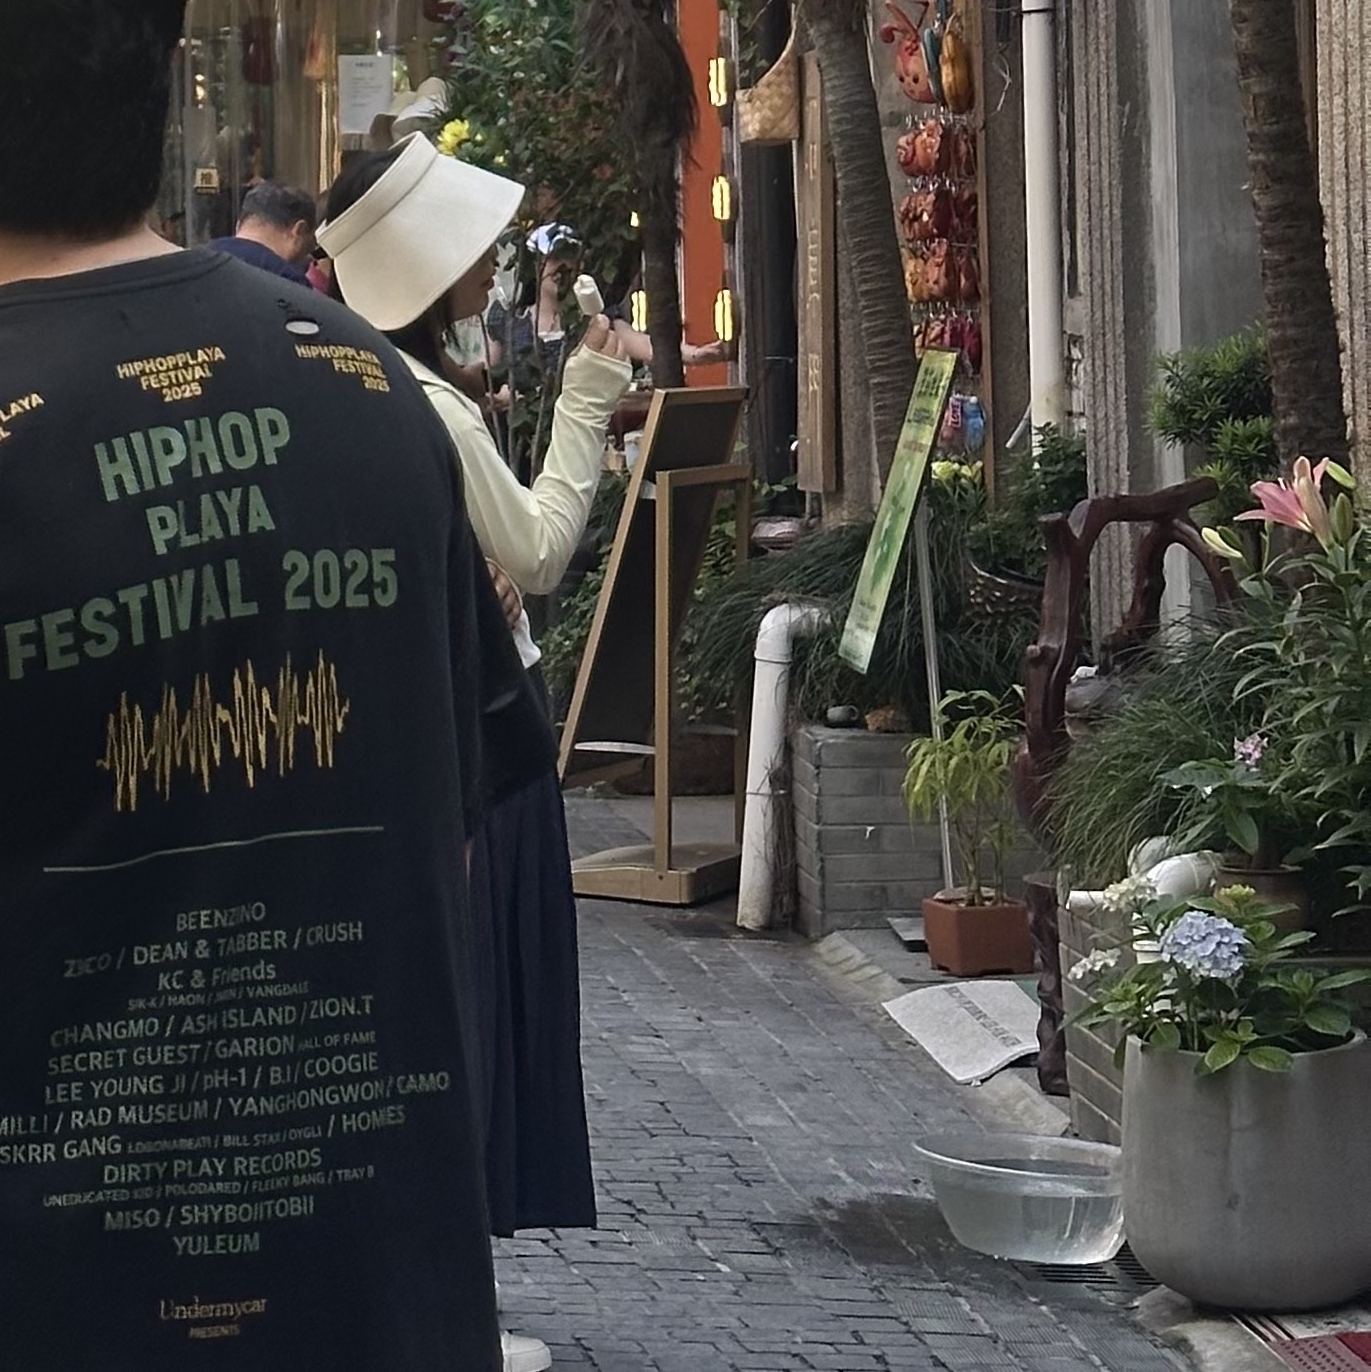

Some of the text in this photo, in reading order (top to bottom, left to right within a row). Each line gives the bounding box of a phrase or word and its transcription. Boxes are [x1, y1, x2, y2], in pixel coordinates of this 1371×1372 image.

[116, 345, 226, 380] HIPHOPPLAYA
[140, 364, 213, 390] FESTIVAL
[162, 382, 203, 403] 2025
[93, 406, 291, 502] HIPHOP
[144, 484, 276, 556] PLAYA
[3, 548, 399, 680] FESTIVAL 2025
[176, 901, 266, 932] BEENZINO
[133, 941, 188, 966] DEAN
[217, 930, 288, 957] TABBER
[306, 921, 364, 947] CRUSH
[211, 959, 277, 987] Friends
[50, 1017, 159, 1049] CHANGMO
[181, 1012, 219, 1036] ASH
[222, 1004, 297, 1032] ISLAND
[308, 994, 373, 1021] ZION.T
[47, 1048, 128, 1076] SECRET
[132, 1043, 202, 1067] GUEST
[215, 1034, 295, 1059] GARION
[323, 1033, 341, 1048] OF
[343, 1030, 377, 1046] FAME
[44, 1081, 84, 1106] LEE
[89, 1075, 164, 1100] YOUNG
[170, 1073, 186, 1095] JI
[202, 1068, 247, 1092] pH-1
[304, 1052, 380, 1079] COOGIE
[70, 1106, 112, 1130] RAD
[117, 1099, 209, 1127] MUSEUM
[229, 1081, 384, 1118] YANGHONGWON
[63, 1134, 123, 1160] GANG
[103, 1146, 323, 1186] DIRTY PLAY RECORDS
[103, 1208, 161, 1232] MISO
[171, 1231, 260, 1257] YULEUM
[159, 1294, 268, 1322] Undermycar
